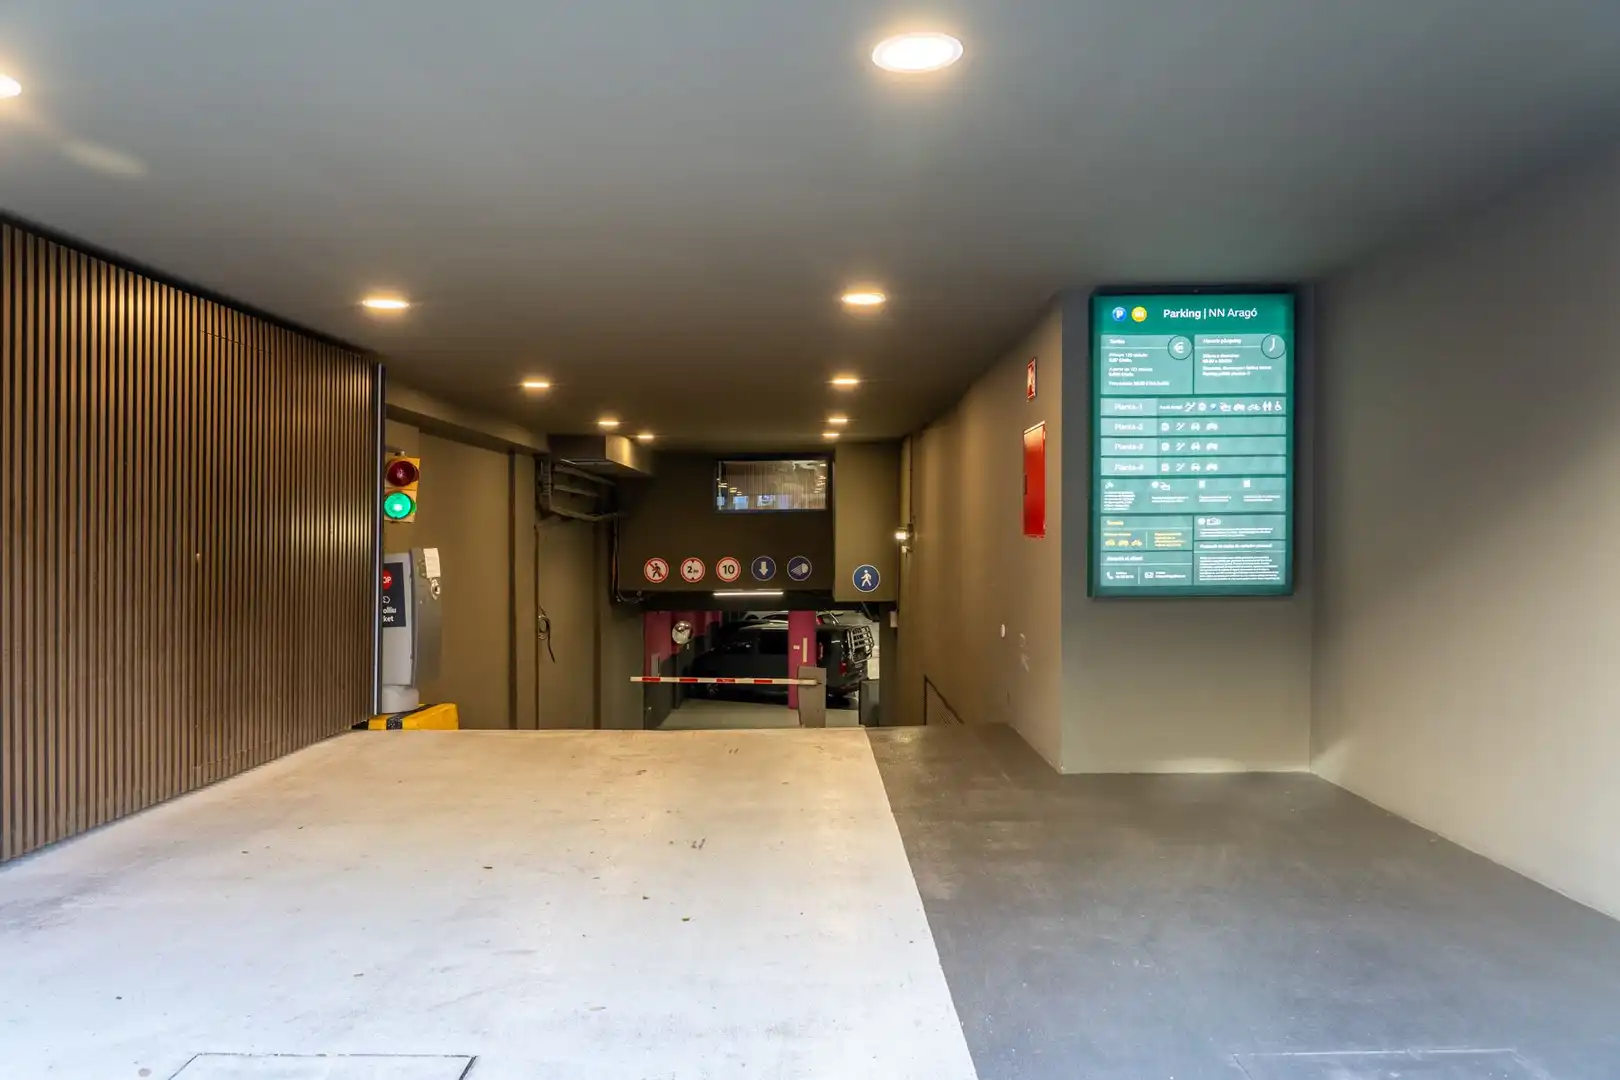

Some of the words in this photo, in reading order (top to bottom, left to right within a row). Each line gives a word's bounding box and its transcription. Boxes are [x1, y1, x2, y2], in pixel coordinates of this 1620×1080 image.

[1163, 308, 1201, 320] Parking
[1208, 308, 1225, 318] NN
[1227, 308, 1258, 319] Aragó
[722, 564, 735, 575] 10
